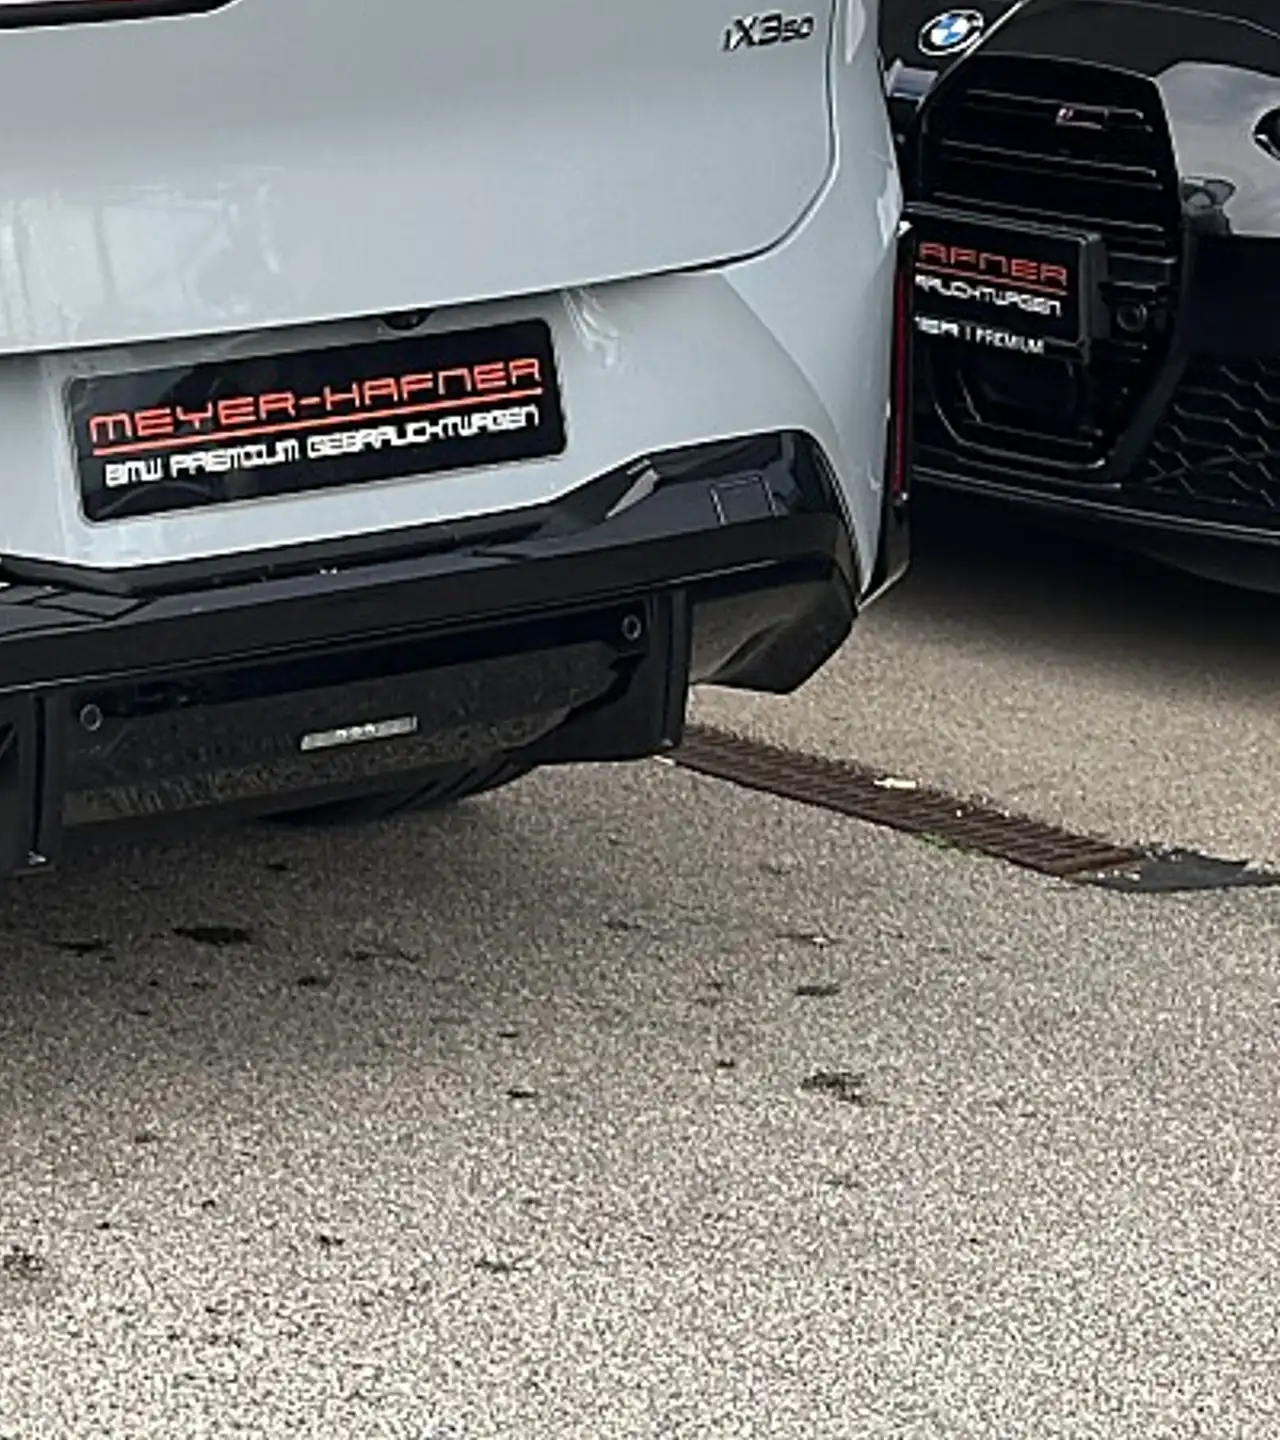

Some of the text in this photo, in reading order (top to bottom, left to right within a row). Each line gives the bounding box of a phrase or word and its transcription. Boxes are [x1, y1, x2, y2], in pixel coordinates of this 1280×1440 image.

[914, 273, 1062, 318] RAUCHTWAGEN
[918, 242, 1068, 287] AFNER
[90, 357, 542, 444] MEYER-HAFNER
[104, 403, 540, 488] BMW PREMIUM GEBRAUCHTWAGEN
